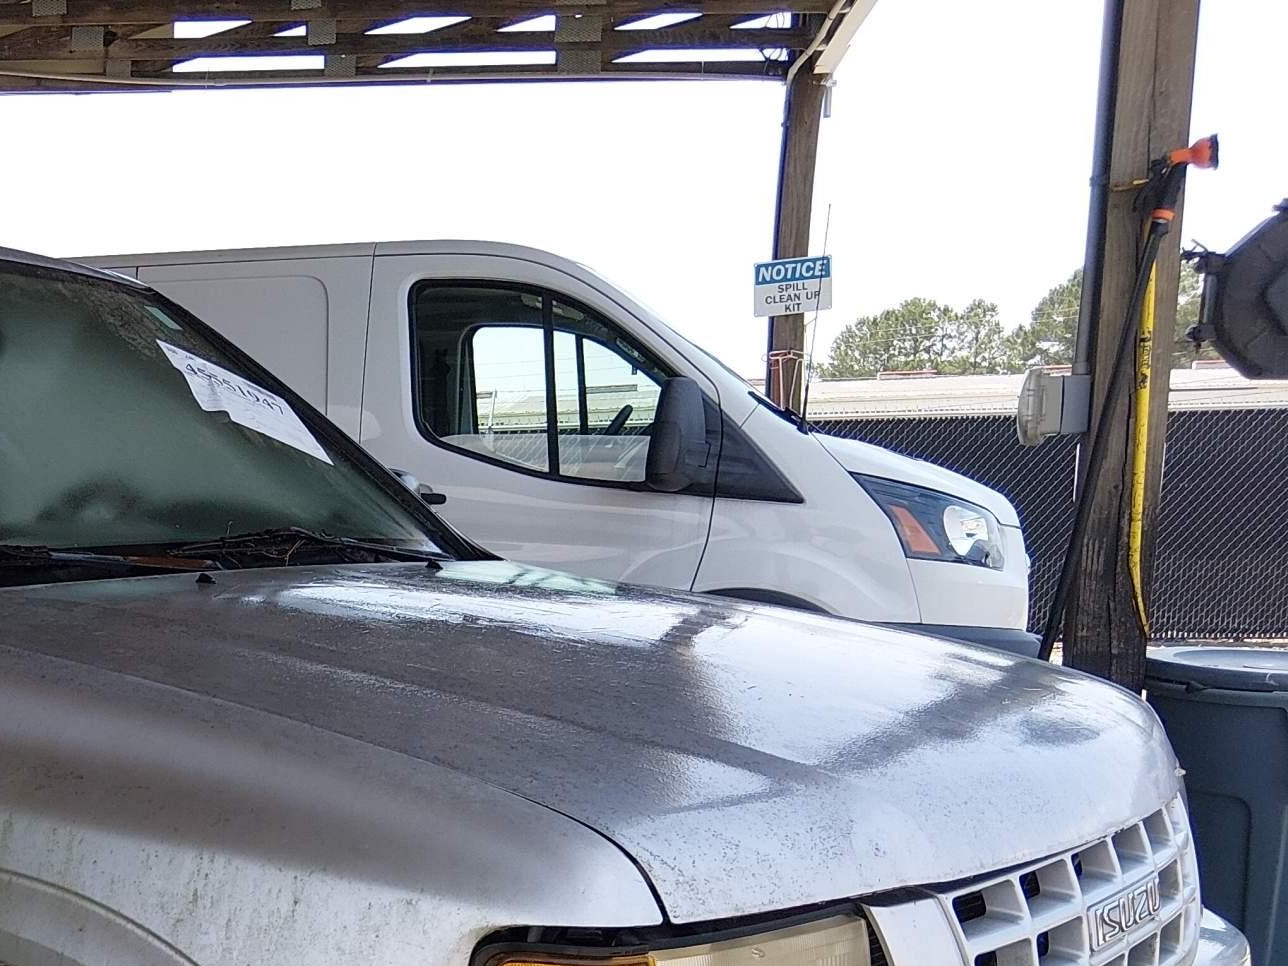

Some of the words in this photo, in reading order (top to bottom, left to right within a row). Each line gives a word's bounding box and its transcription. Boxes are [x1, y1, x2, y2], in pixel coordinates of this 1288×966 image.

[758, 260, 827, 282] NOTICE
[777, 281, 808, 293] SPILL
[765, 293, 801, 305] CLEAN
[805, 290, 820, 300] UP
[784, 302, 802, 313] KIT
[1095, 877, 1161, 947] ISUZU
